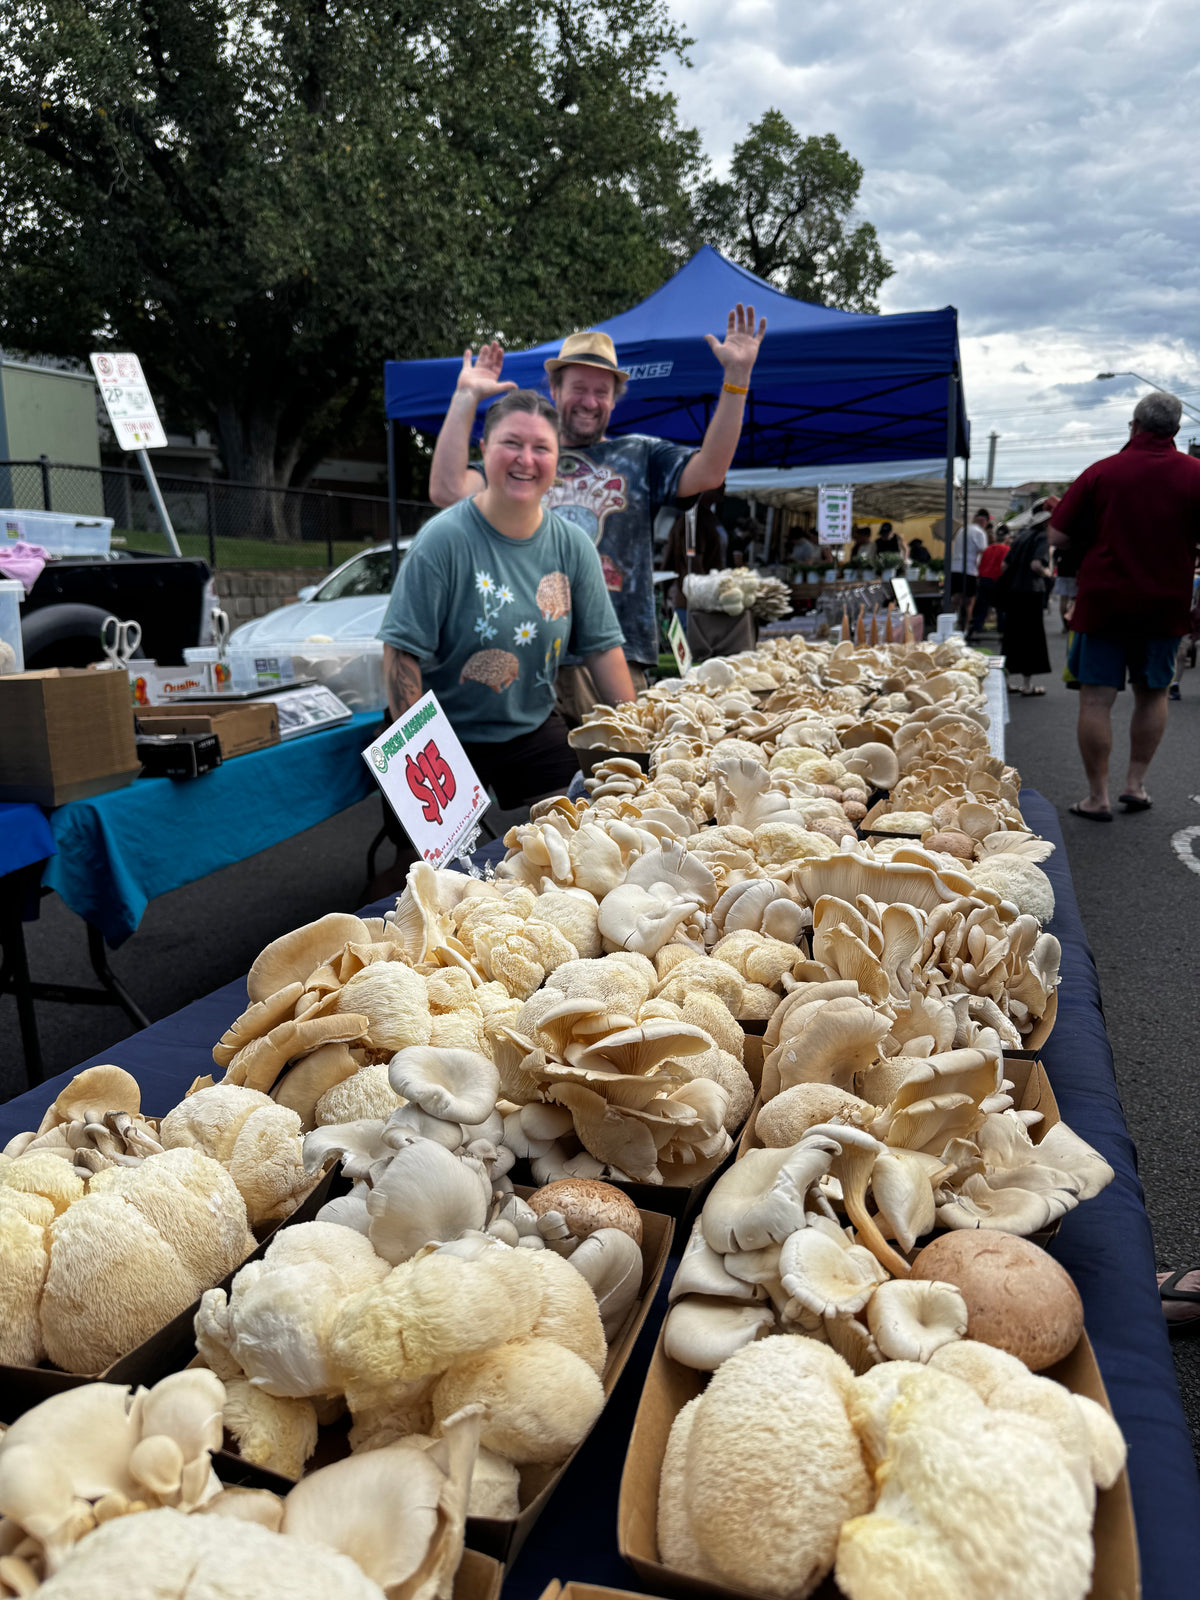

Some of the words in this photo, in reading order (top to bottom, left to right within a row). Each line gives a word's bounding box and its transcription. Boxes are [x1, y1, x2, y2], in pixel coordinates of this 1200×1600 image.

[104, 387, 123, 403] 2P
[382, 732, 406, 761] FRESH
[401, 702, 437, 742] MUSHROOMS
[405, 739, 456, 825] $15
